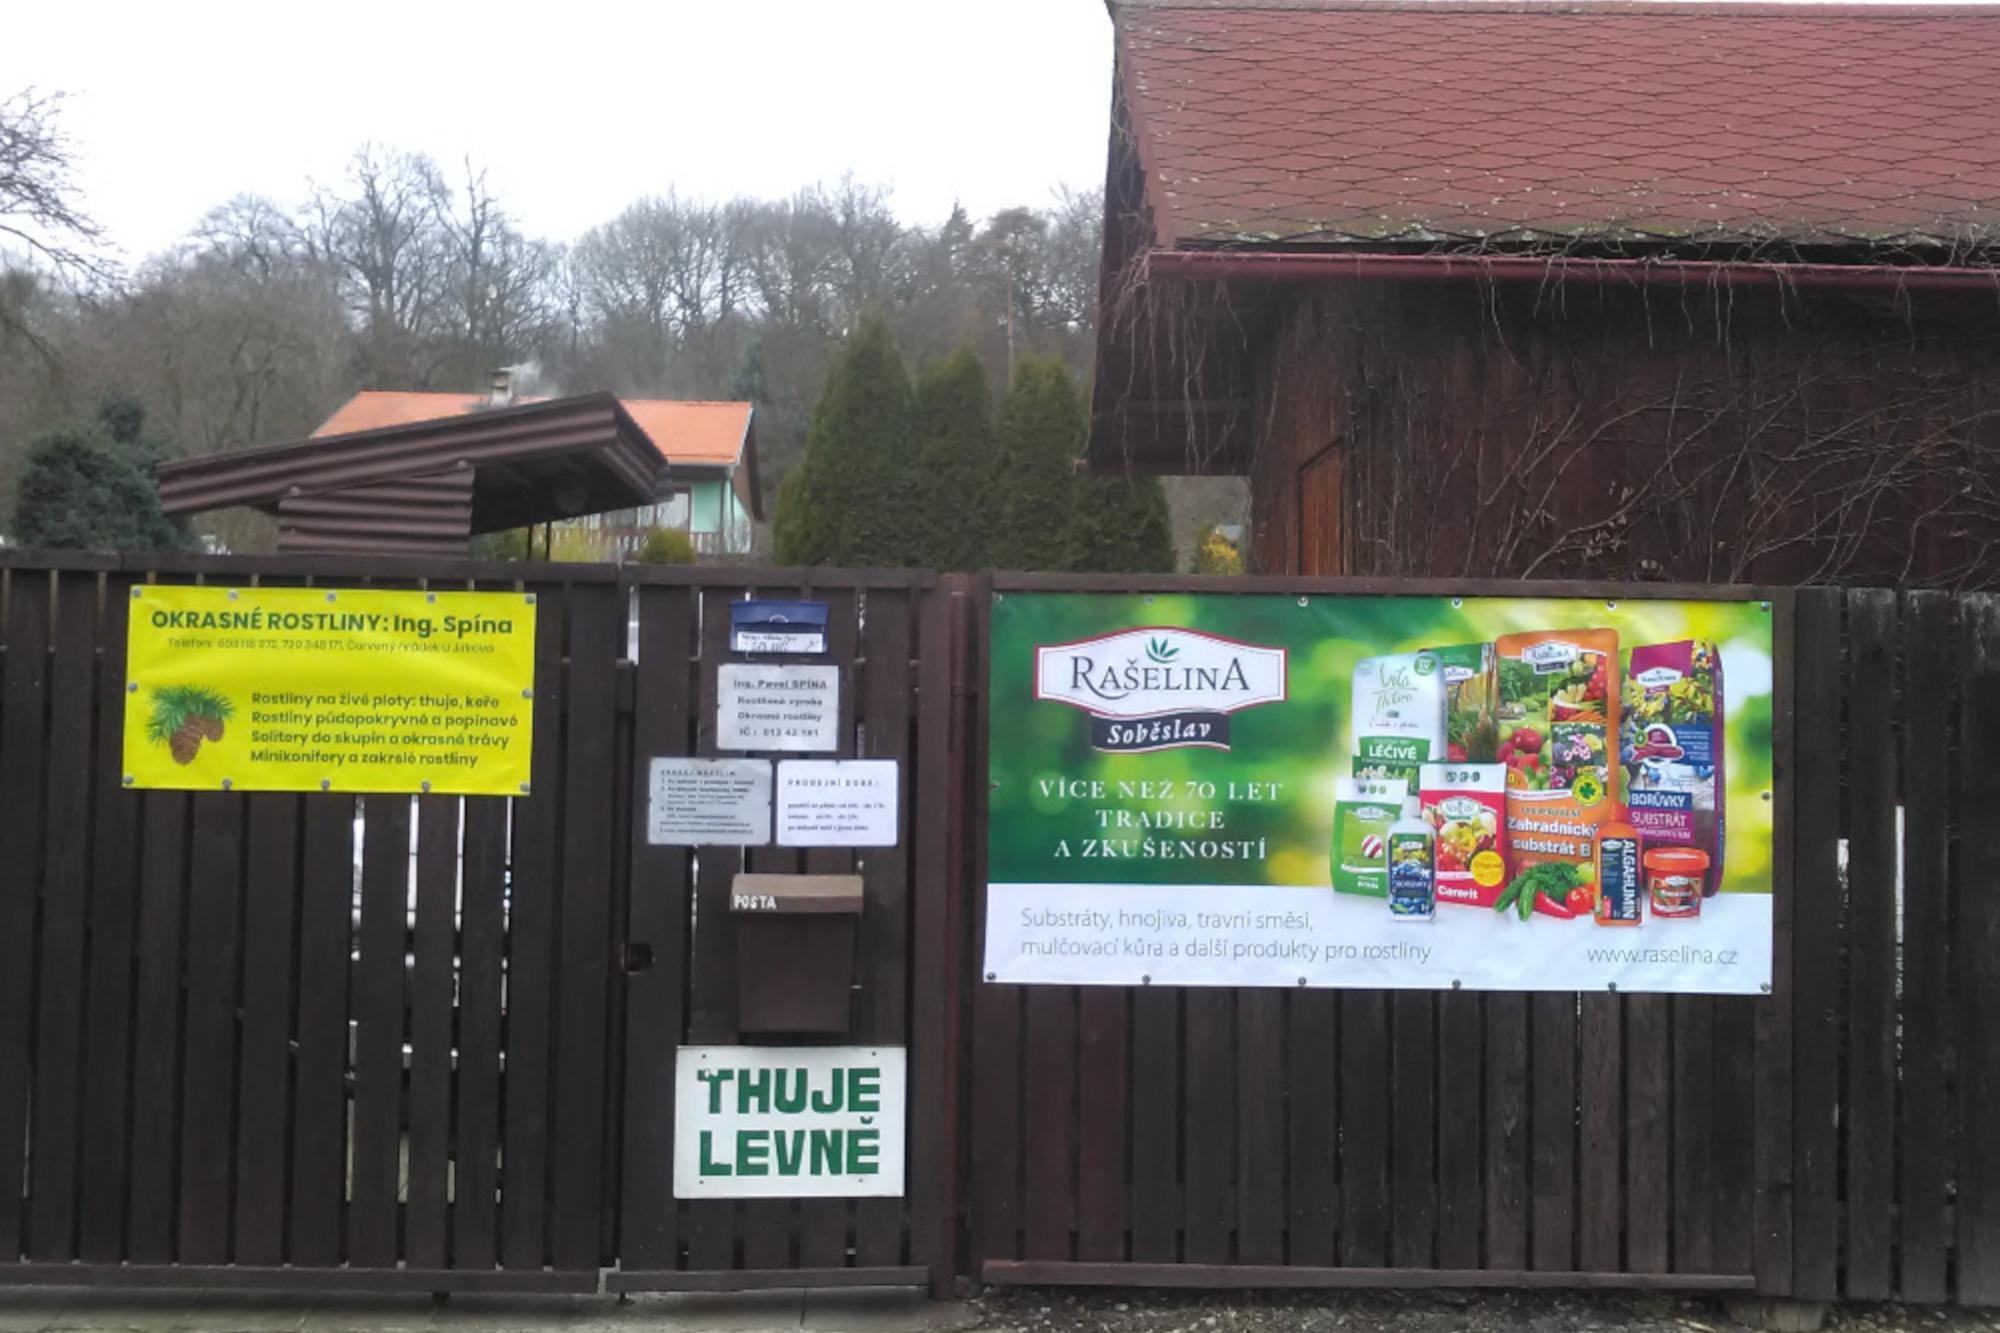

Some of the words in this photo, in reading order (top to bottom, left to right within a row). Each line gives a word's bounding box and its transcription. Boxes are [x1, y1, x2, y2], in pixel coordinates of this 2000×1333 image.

[152, 607, 262, 629] OKRASNÉ
[268, 612, 388, 631] ROSTLINY:
[394, 614, 438, 638] Ing.
[444, 614, 513, 639] Spína
[758, 679, 789, 689] Pavel
[1070, 656, 1251, 700] RAŠELINA
[252, 692, 312, 708] Rostliny
[316, 695, 336, 705] na
[339, 692, 369, 705] živé
[373, 694, 416, 710] ploty:
[420, 695, 463, 710] thuje,
[252, 711, 312, 727] Rostliny
[432, 716, 441, 726] a
[252, 730, 308, 746] Solitery
[312, 732, 331, 743] do
[335, 732, 385, 748] skupin
[389, 735, 399, 745] a
[403, 732, 464, 745] okrasné
[468, 733, 510, 750] trávy
[1107, 718, 1212, 745] Soběslav
[251, 750, 344, 767] Minikonifery
[349, 753, 358, 763] a
[420, 752, 478, 768] rostliny
[1368, 742, 1418, 760] LÉČIVÉ
[1039, 776, 1106, 800] VÍCE
[1118, 778, 1175, 800] NEŽ
[1185, 780, 1216, 800] 70
[1228, 781, 1282, 801] LET
[1631, 791, 1685, 808] BORŮVKY
[1095, 809, 1226, 829] TRADICE
[1631, 811, 1686, 827] SUBSTRÁT
[1054, 839, 1071, 858] A
[1082, 837, 1267, 859] ZKUŠENOSTÍ
[1513, 838, 1575, 855] substrát
[1580, 843, 1591, 857] B
[1622, 839, 1636, 919] ALGAHUMIN
[1021, 907, 1113, 932] Substráty,
[1118, 908, 1192, 932] hnojiva,
[1197, 910, 1251, 929] travní
[1256, 911, 1313, 932] směsí,
[1021, 937, 1118, 957] mulčovací
[1123, 937, 1163, 957] kůra
[1168, 942, 1179, 957] a
[1185, 937, 1227, 958] další
[1233, 939, 1318, 963] produkty
[1325, 944, 1359, 963] pro
[1363, 940, 1431, 965] rostliny
[1586, 944, 1739, 966] www.raselina.cz
[697, 1068, 880, 1114] THUJE
[699, 1116, 880, 1176] LEVNĚ
